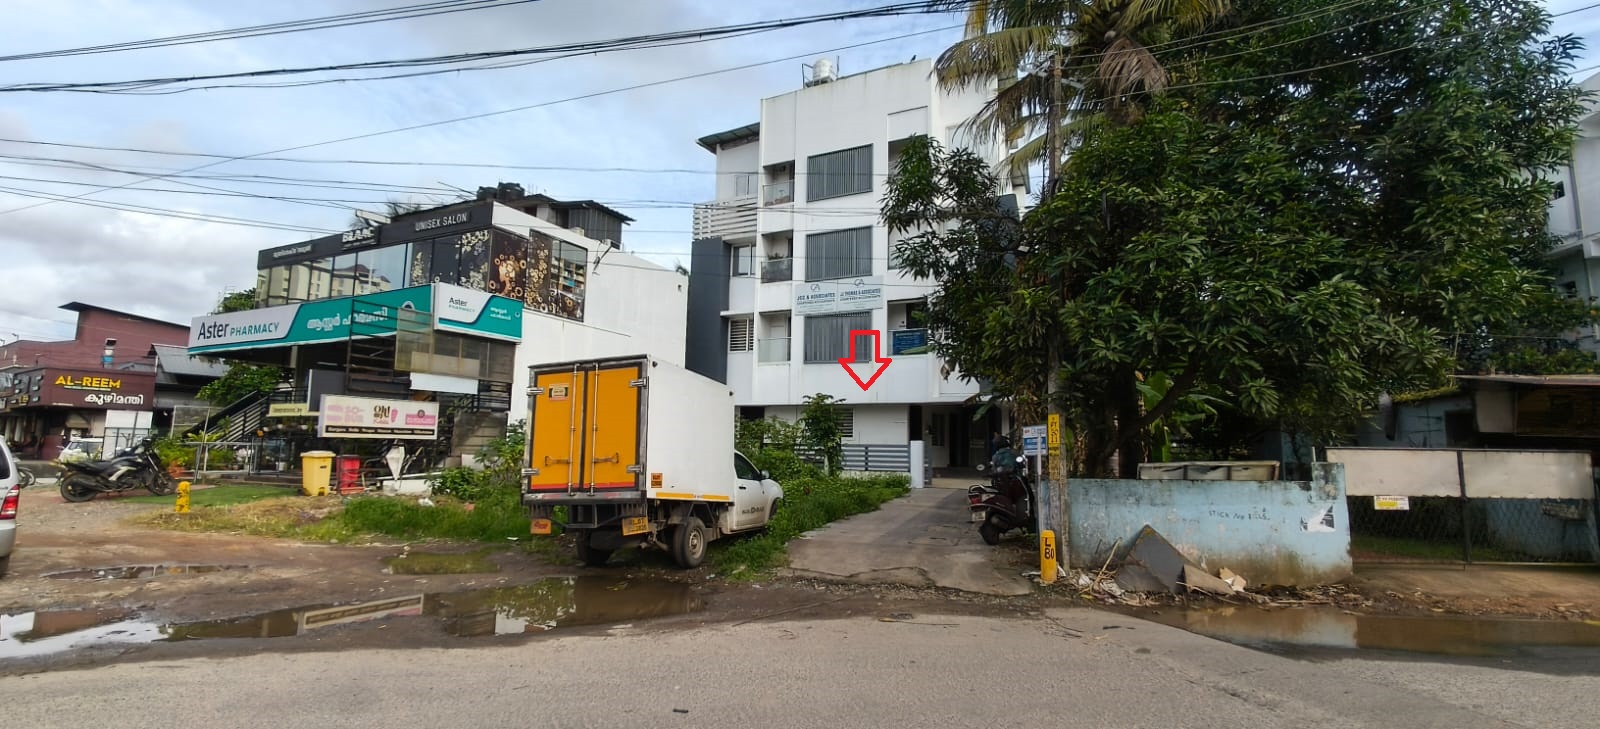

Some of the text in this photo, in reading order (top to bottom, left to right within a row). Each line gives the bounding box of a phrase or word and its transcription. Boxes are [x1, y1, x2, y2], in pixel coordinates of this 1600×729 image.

[415, 213, 468, 231] UNISEX SALON
[449, 297, 470, 307] Aster
[198, 321, 281, 340] Aster PHARMACY
[55, 375, 121, 389] AL-REEM
[1045, 537, 1051, 547] L
